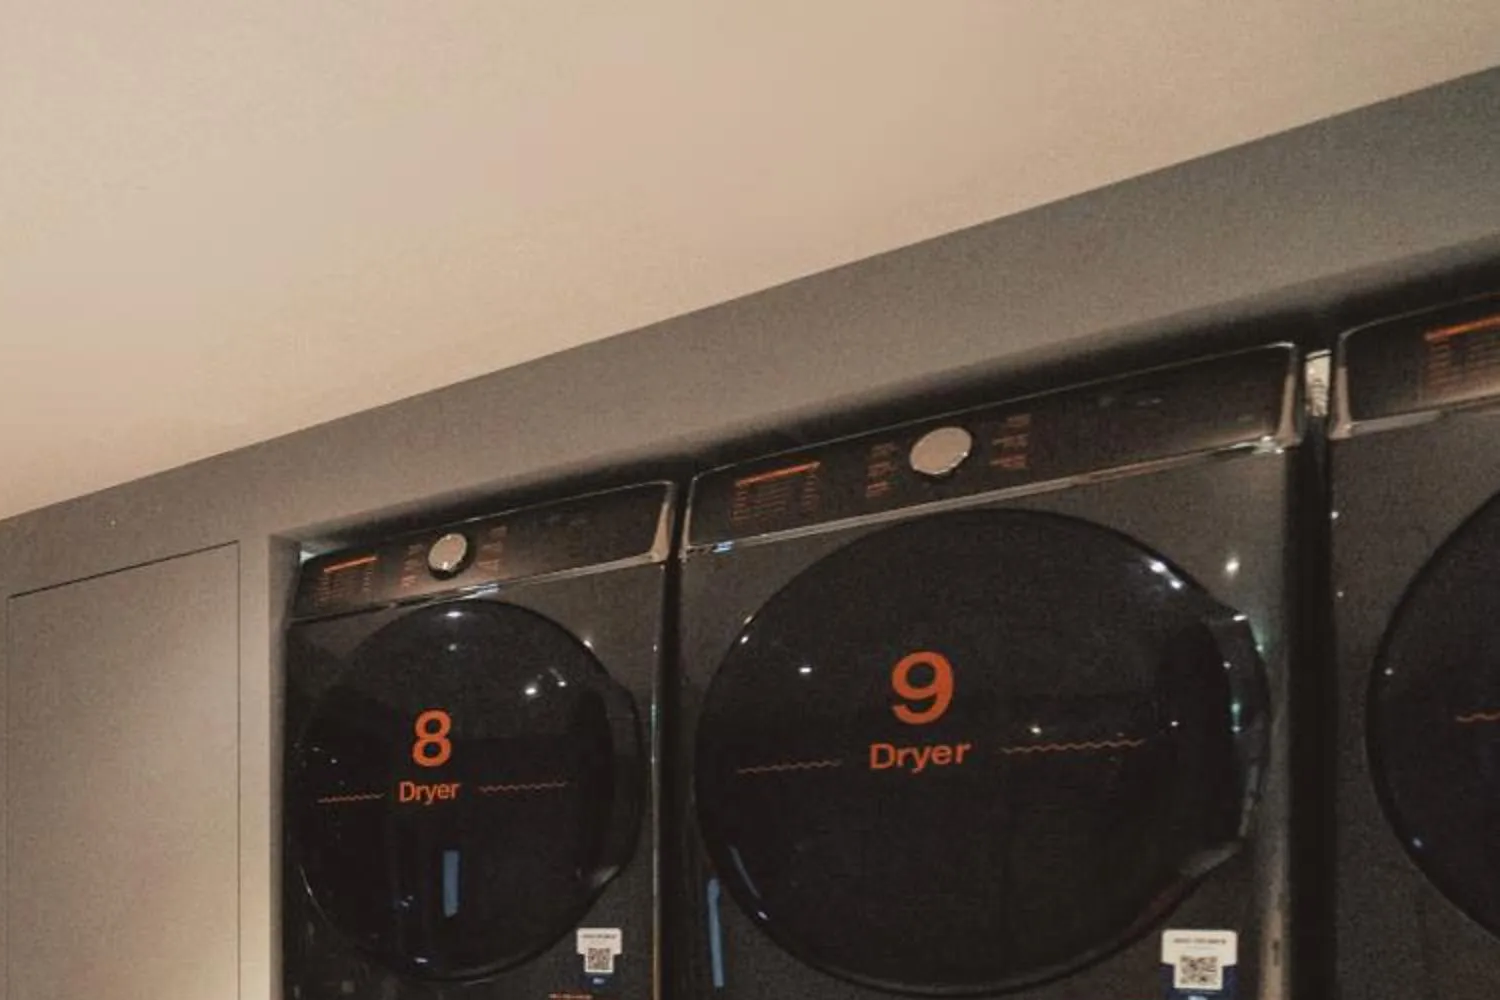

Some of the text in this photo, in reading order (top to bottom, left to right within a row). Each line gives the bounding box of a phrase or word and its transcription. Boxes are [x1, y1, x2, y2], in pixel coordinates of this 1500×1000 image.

[891, 650, 954, 725] 9
[412, 709, 453, 767] 8
[871, 742, 971, 773] Dryer
[399, 781, 461, 805] Dryer
